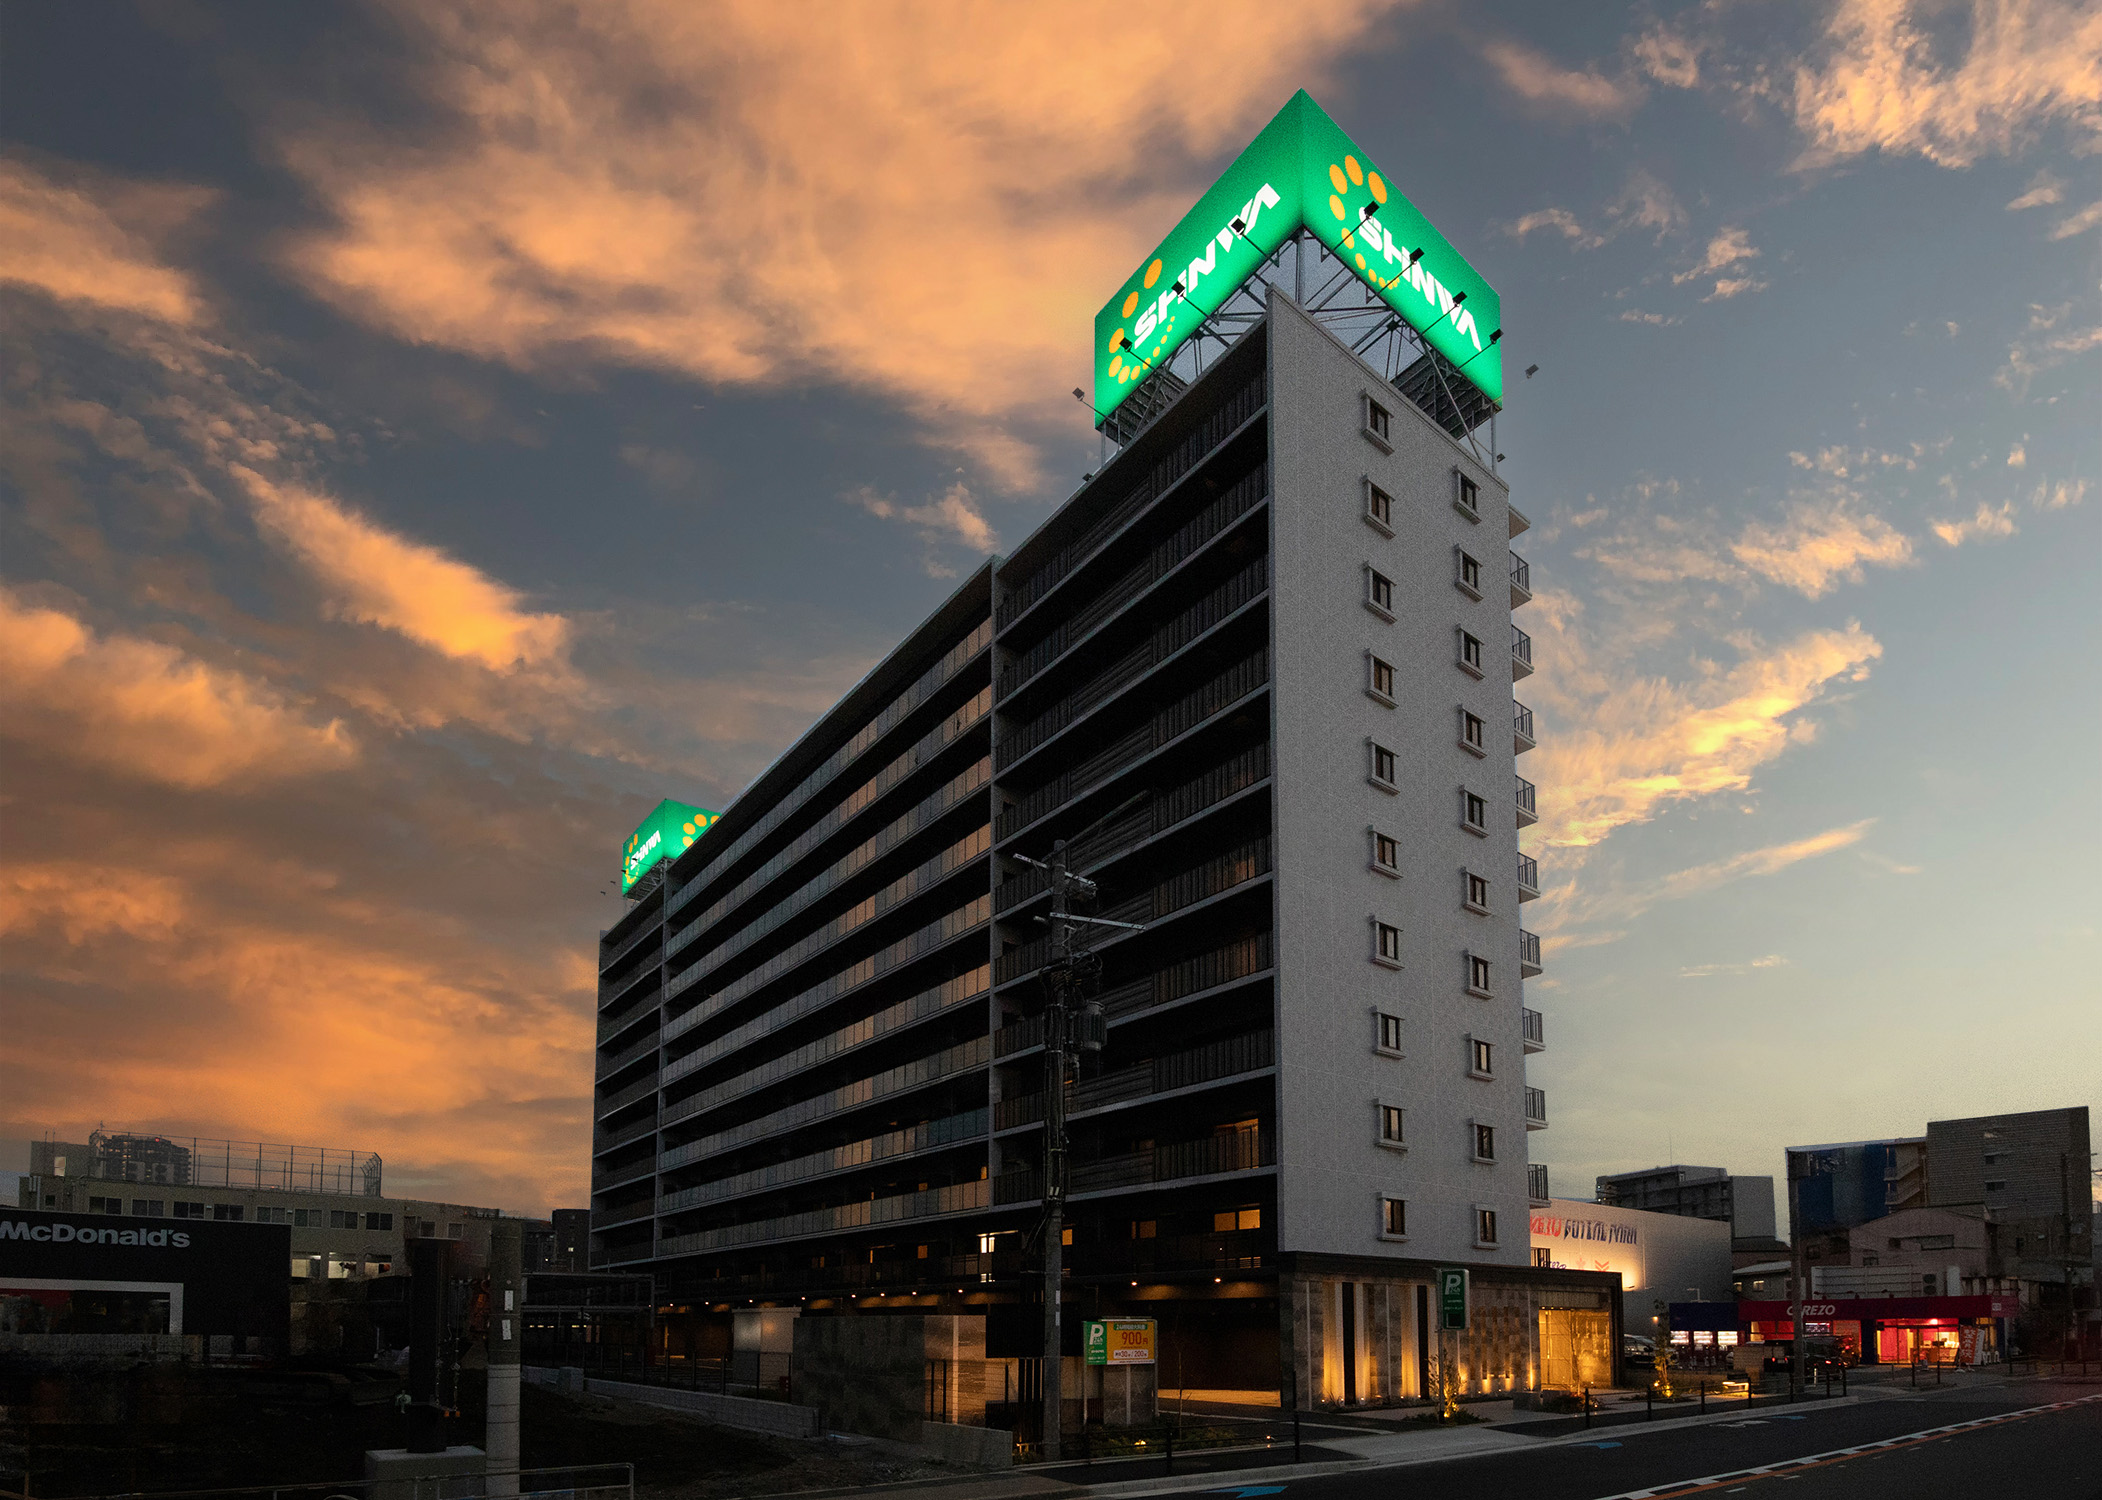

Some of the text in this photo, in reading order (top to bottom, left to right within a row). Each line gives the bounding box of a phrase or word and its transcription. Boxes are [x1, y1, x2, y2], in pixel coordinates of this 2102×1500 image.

[1134, 183, 1281, 349] SHINWA
[1358, 207, 1481, 351] SHINWA
[0, 1221, 191, 1248] McDonald's
[1445, 1274, 1462, 1295] P
[1786, 1304, 1836, 1316] CREZO
[1089, 1324, 1104, 1345] P
